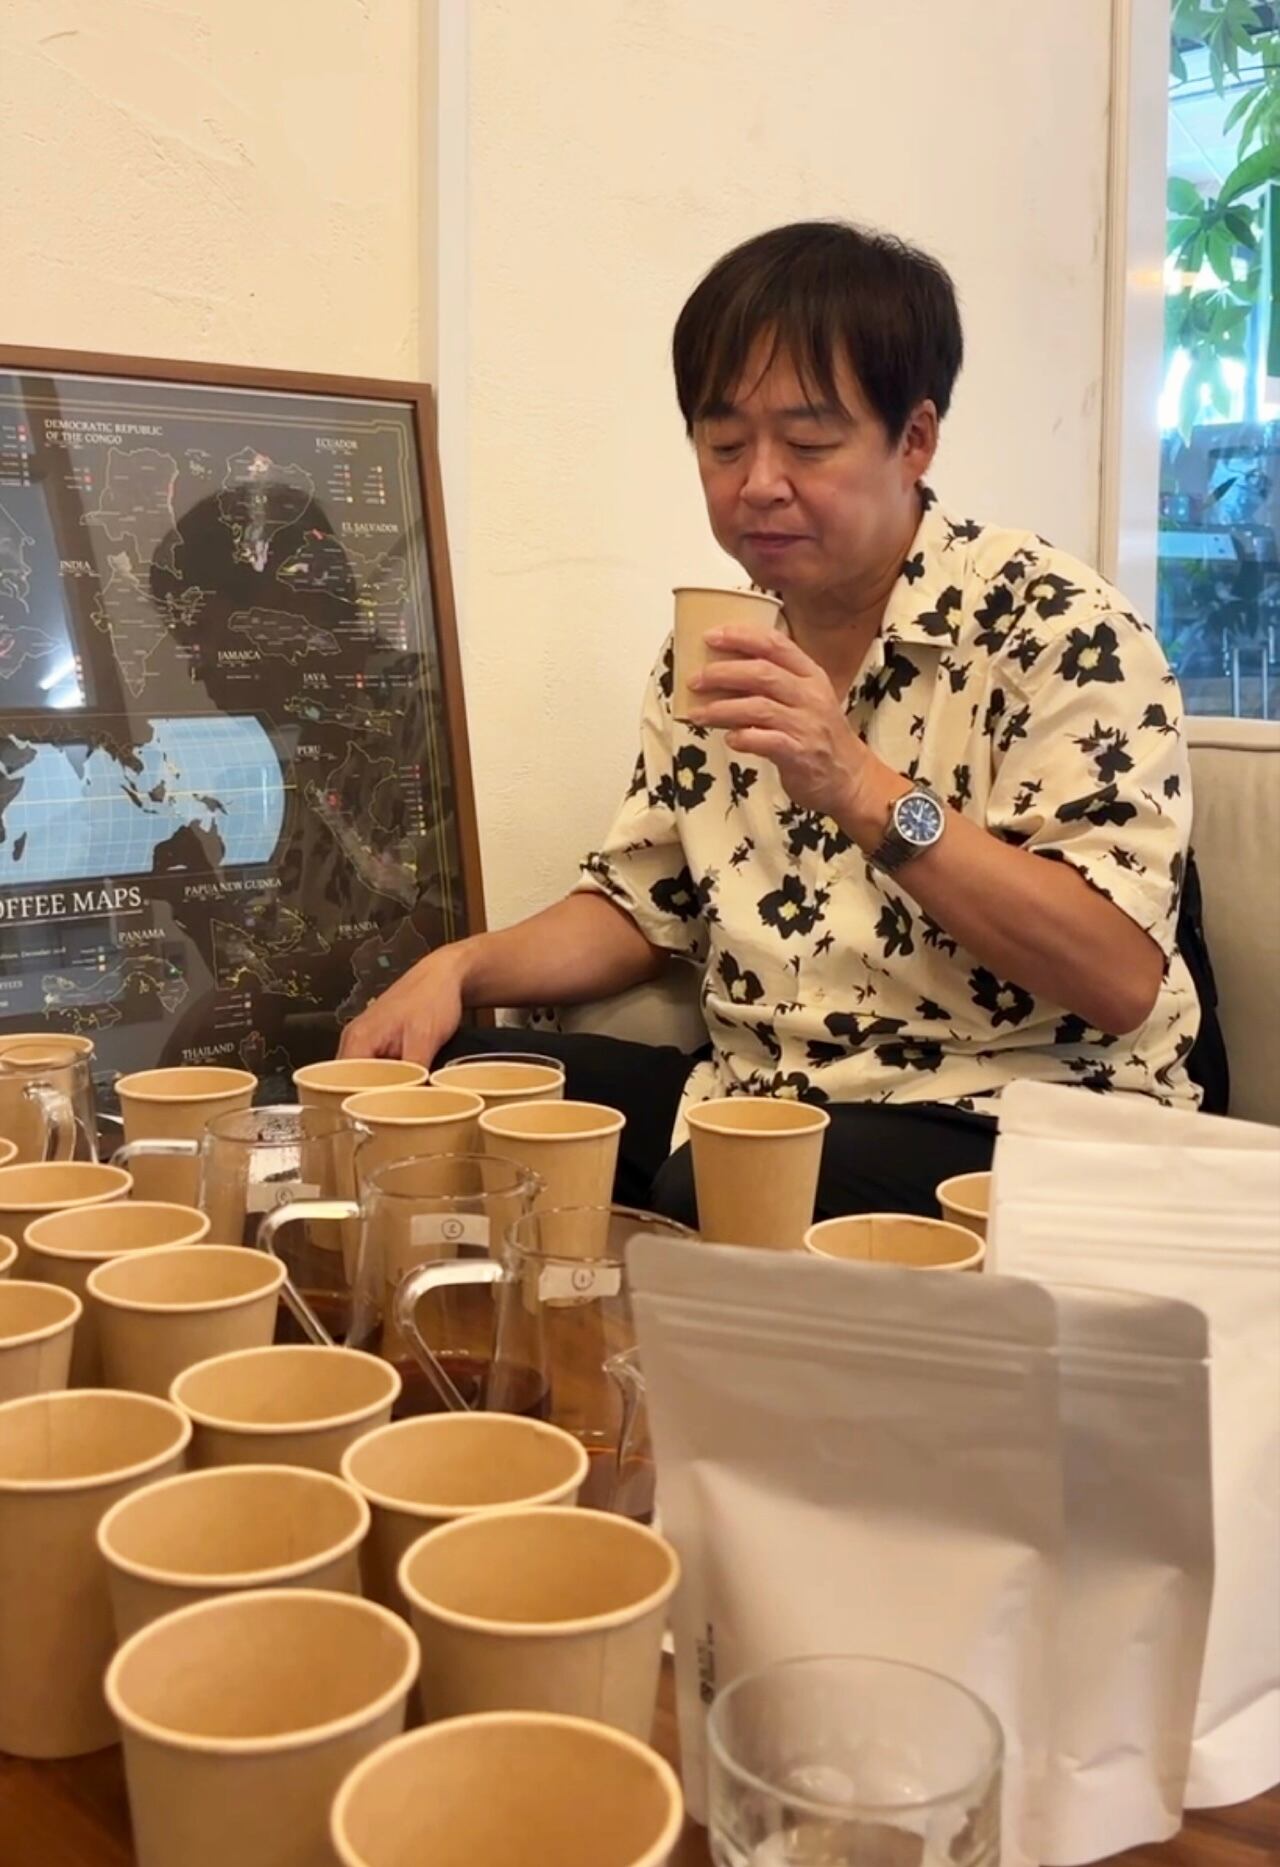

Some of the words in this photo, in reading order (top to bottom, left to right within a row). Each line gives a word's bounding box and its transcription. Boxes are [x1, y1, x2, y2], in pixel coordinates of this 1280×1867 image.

[44, 418, 112, 433] DEMOCRATIC
[115, 423, 163, 436] REPUBLIC
[46, 431, 59, 441] OF
[61, 432, 82, 443] THE
[84, 433, 122, 445] CONGO
[315, 438, 358, 450] ECUADOR
[341, 522, 353, 532] EL
[354, 522, 399, 533] SALVADOR
[60, 560, 91, 570] INDIA
[217, 650, 261, 661] JAMAICA
[303, 673, 327, 682] JAVA
[297, 745, 321, 756] PERU
[184, 883, 219, 896] PAPUA
[220, 881, 243, 892] NEW
[244, 878, 282, 890] GUINEA
[0, 893, 67, 919] FFEE
[72, 886, 142, 912] MAPS
[118, 927, 166, 942] PANAMA
[181, 1041, 235, 1060] THAILAND
